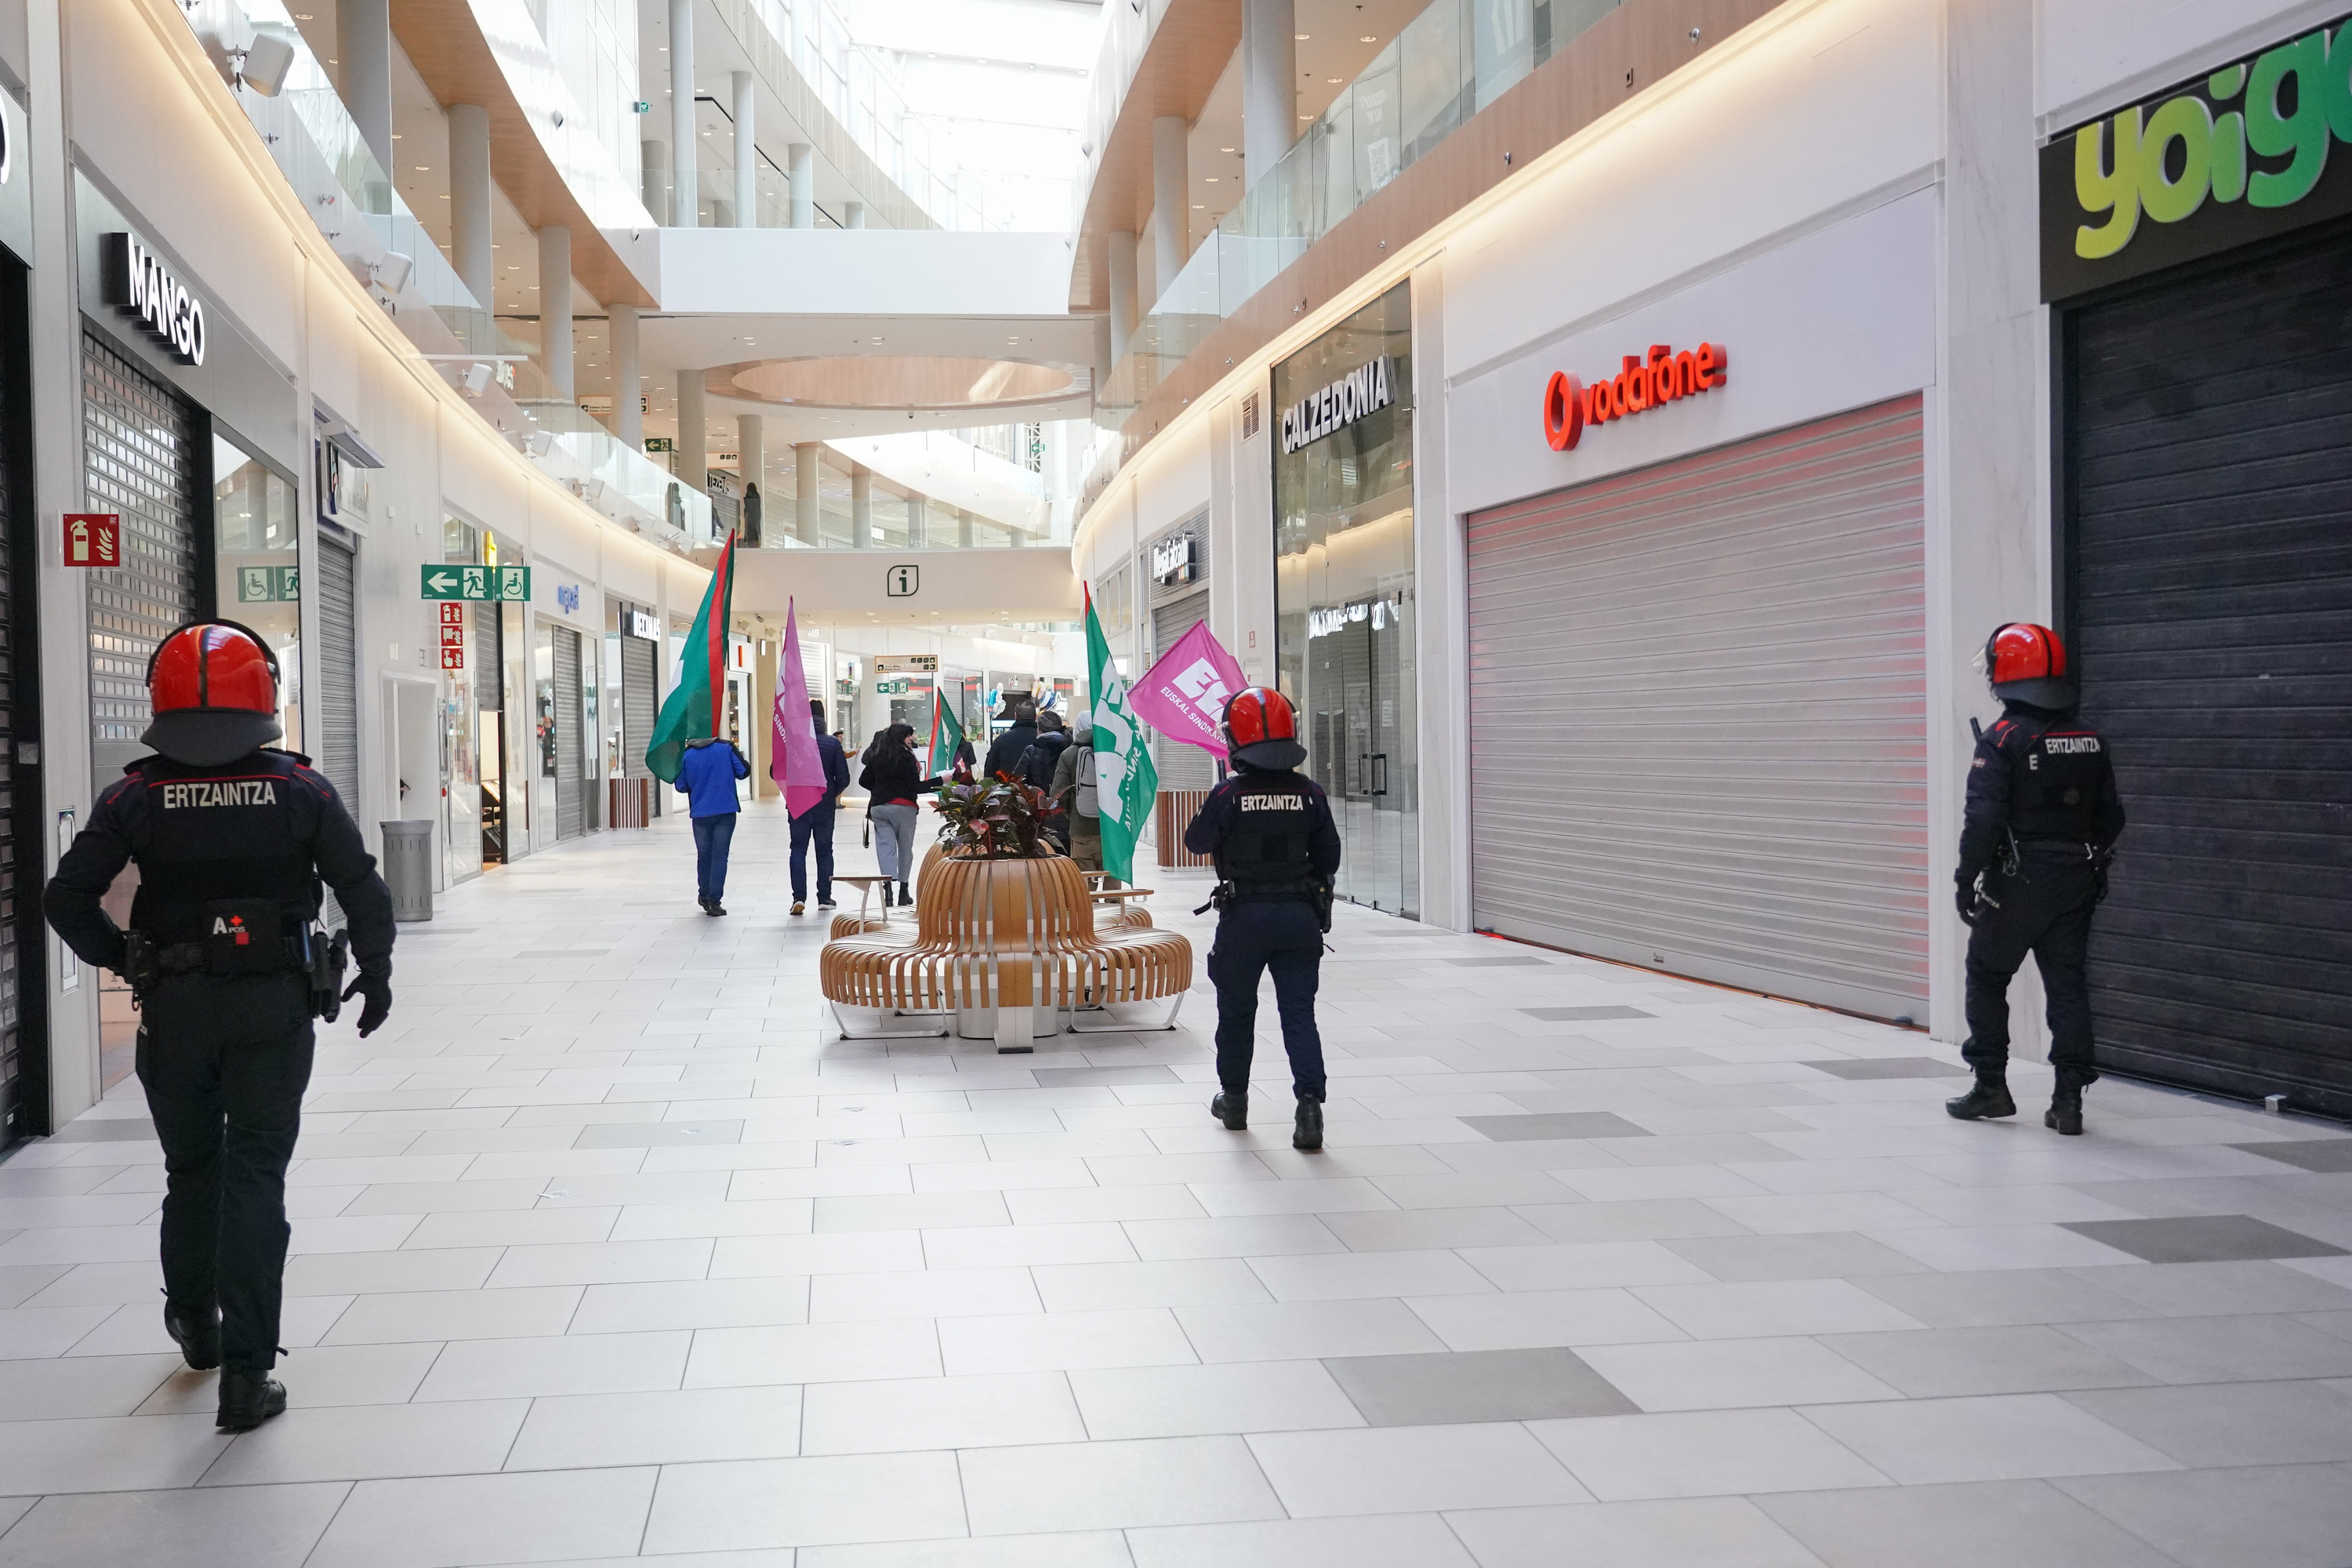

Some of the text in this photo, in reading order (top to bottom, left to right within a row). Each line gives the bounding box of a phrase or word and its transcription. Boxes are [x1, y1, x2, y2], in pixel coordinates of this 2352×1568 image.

[128, 232, 205, 366] MANGO
[1282, 355, 1394, 455] CALZEDONIA
[1580, 342, 1727, 426] vodafone
[1160, 686, 1190, 714] EUSKAL
[1171, 657, 1231, 722] EL
[2045, 737, 2101, 754] ERTZAINTZA
[163, 782, 277, 808] ERTZAINTZA
[1240, 794, 1304, 811] ERTZAINTZA
